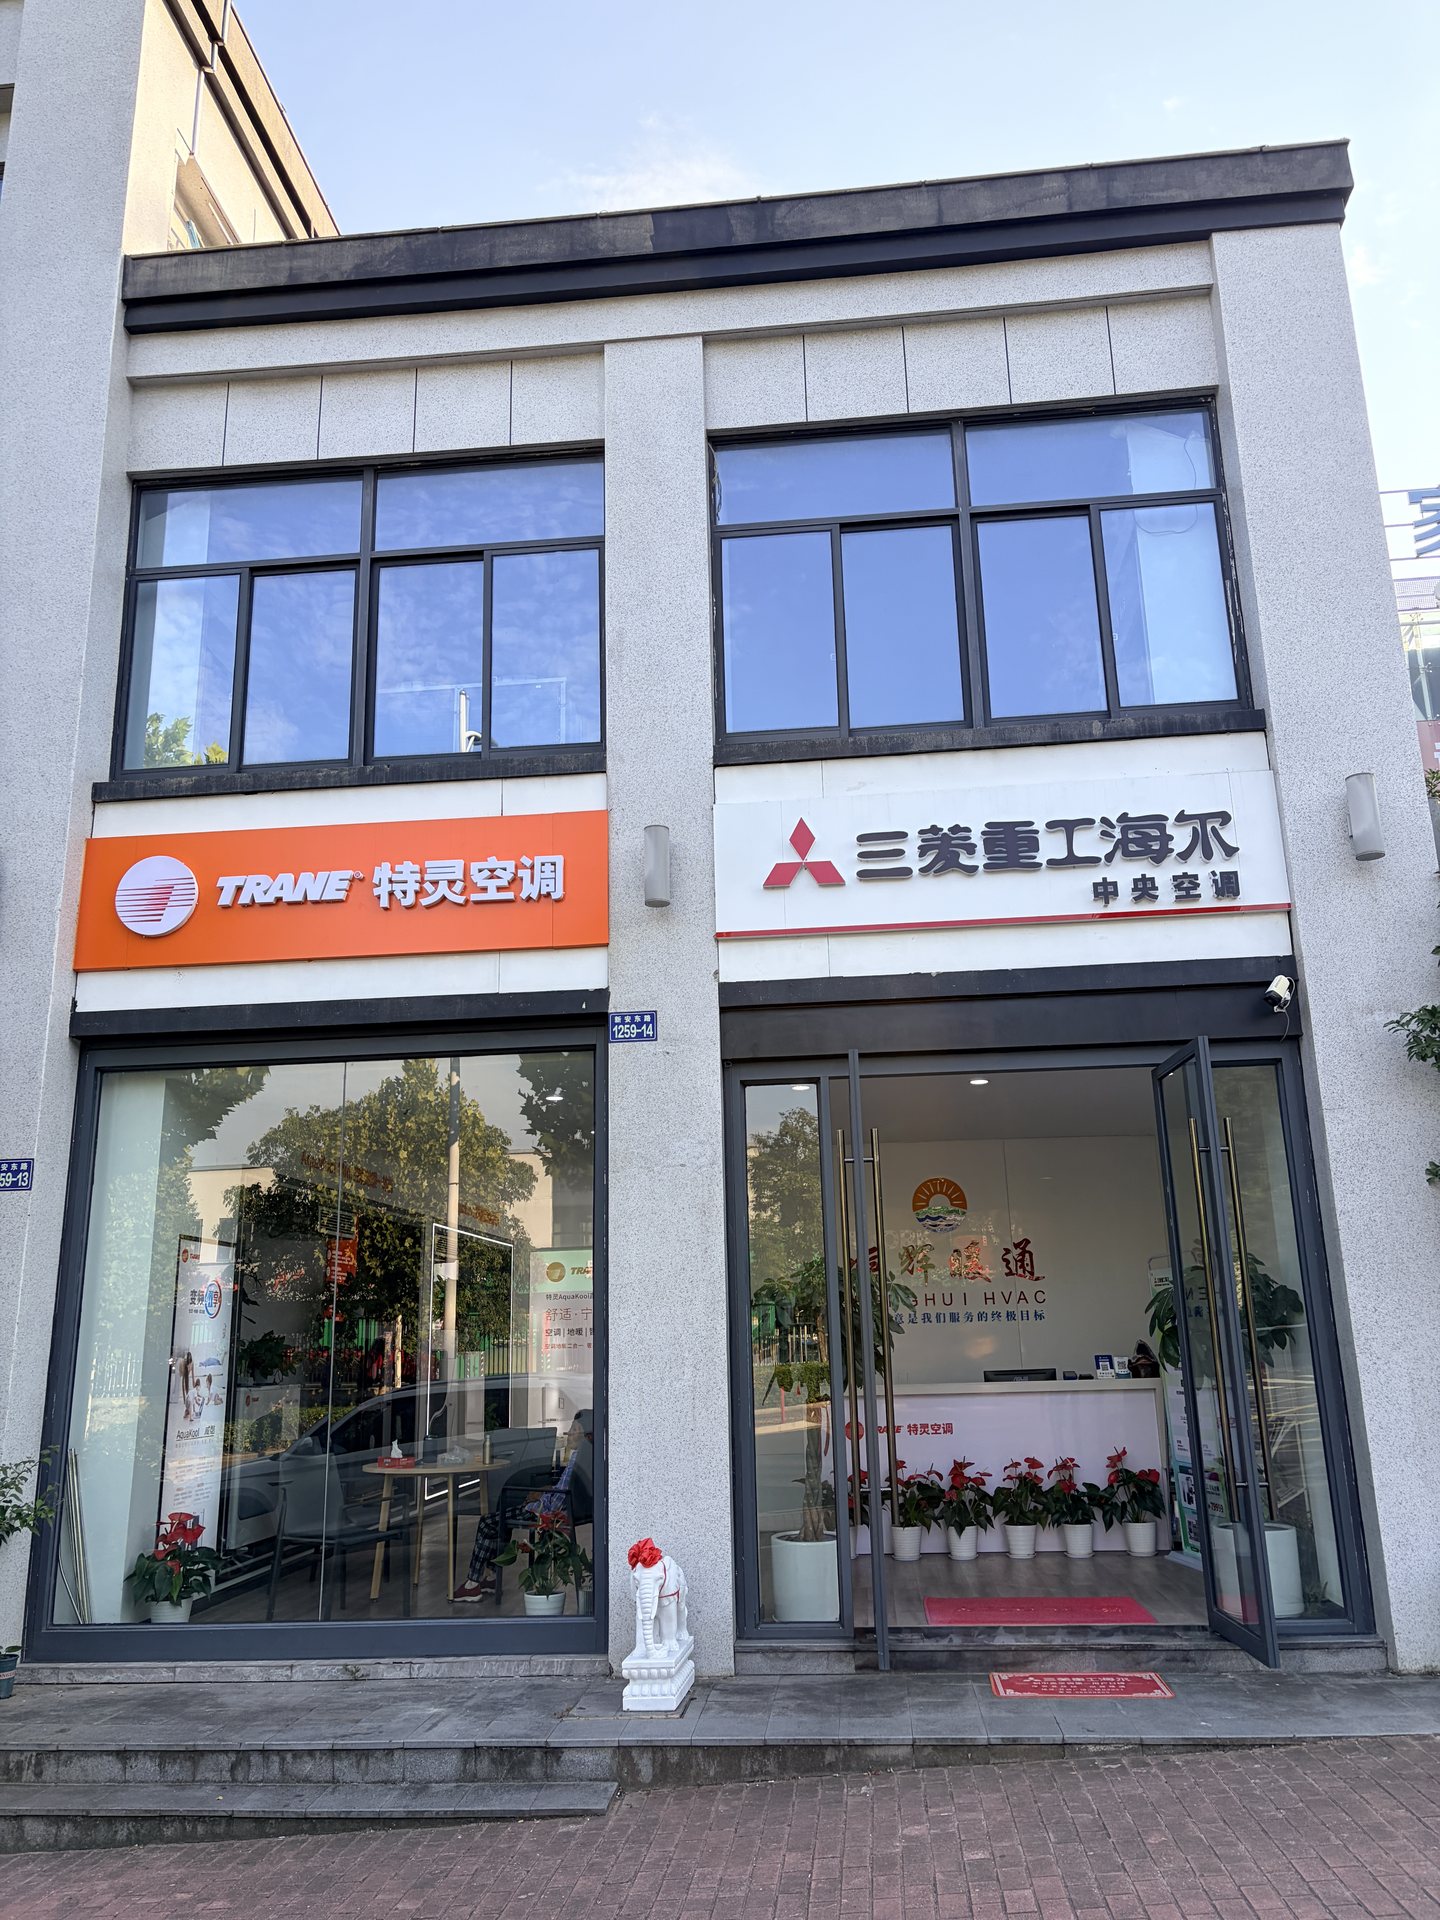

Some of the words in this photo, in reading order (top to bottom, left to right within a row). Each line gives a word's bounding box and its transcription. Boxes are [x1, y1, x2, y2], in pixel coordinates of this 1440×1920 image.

[856, 809, 1240, 880] 三菱重工海尔
[372, 854, 566, 910] 特灵空调
[1092, 870, 1242, 907] 中央空调
[612, 1023, 654, 1039] 1259-14
[984, 1289, 1047, 1307] HVAC
[906, 1423, 954, 1436] 特灵空调
